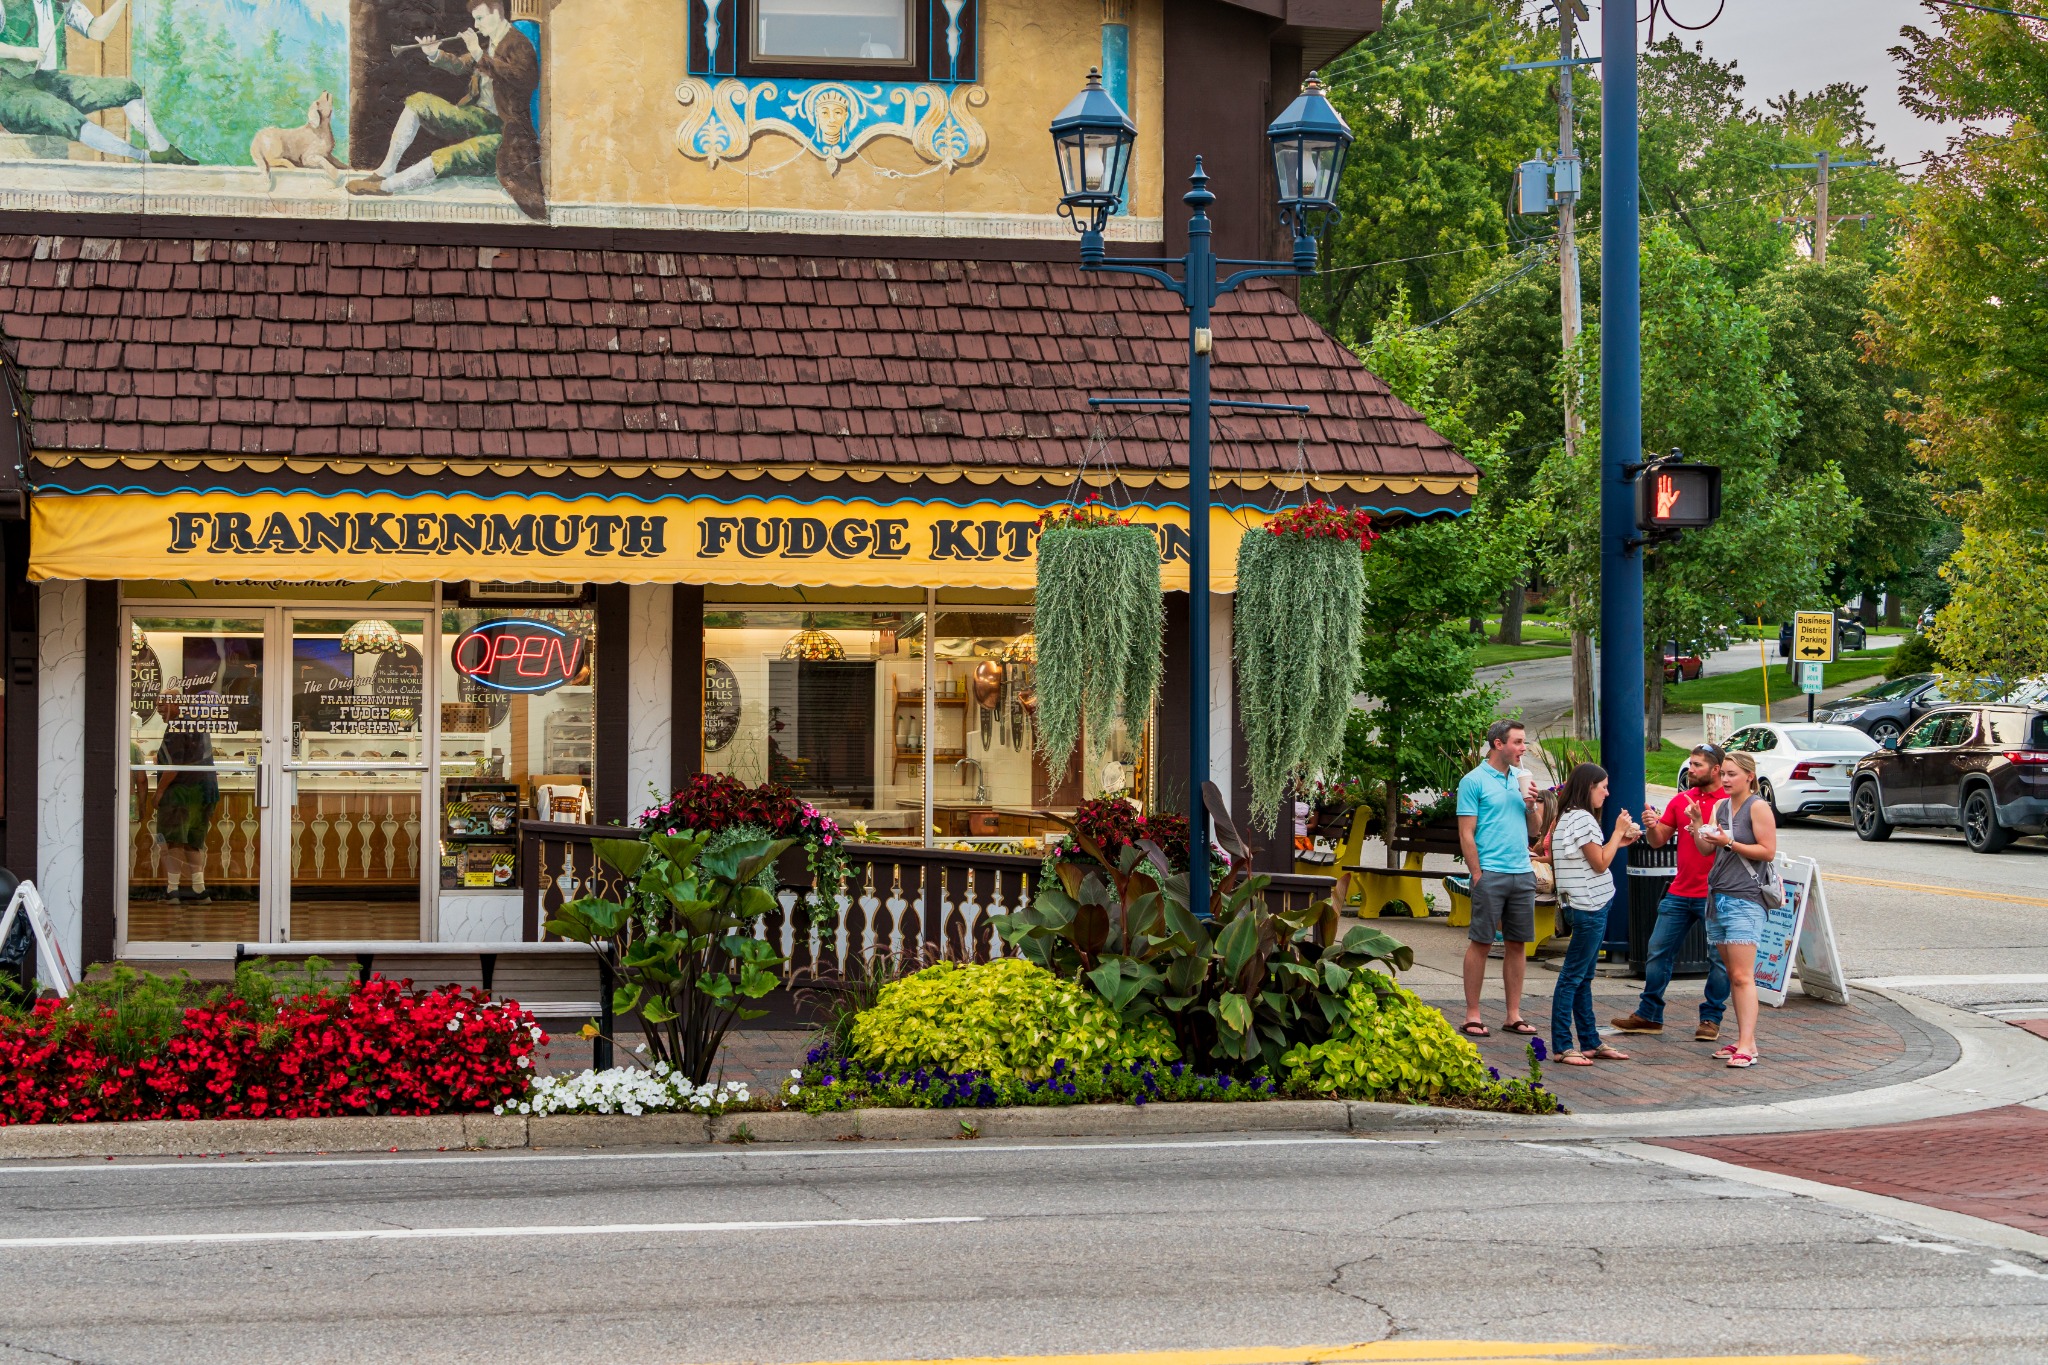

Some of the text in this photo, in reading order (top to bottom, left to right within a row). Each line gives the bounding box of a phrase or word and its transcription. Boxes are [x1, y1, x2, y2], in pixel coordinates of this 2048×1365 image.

[167, 511, 1190, 564] FRANKENMUTH FUDGE KITN
[1798, 616, 1830, 624] Business
[1801, 626, 1827, 634] District
[1800, 636, 1827, 645] Parking
[456, 632, 580, 678] OPEN
[142, 680, 160, 692] The
[167, 672, 217, 690] Original
[304, 672, 376, 694] The Original
[158, 695, 249, 704] FRANKENMUTH
[320, 695, 410, 705] FRANKENMUTH
[464, 694, 508, 703] RECEIVE
[178, 707, 229, 719] FUDGE
[340, 706, 390, 720] FUDGE
[168, 721, 239, 734] KITCHEN
[329, 721, 400, 734] KITCHEN
